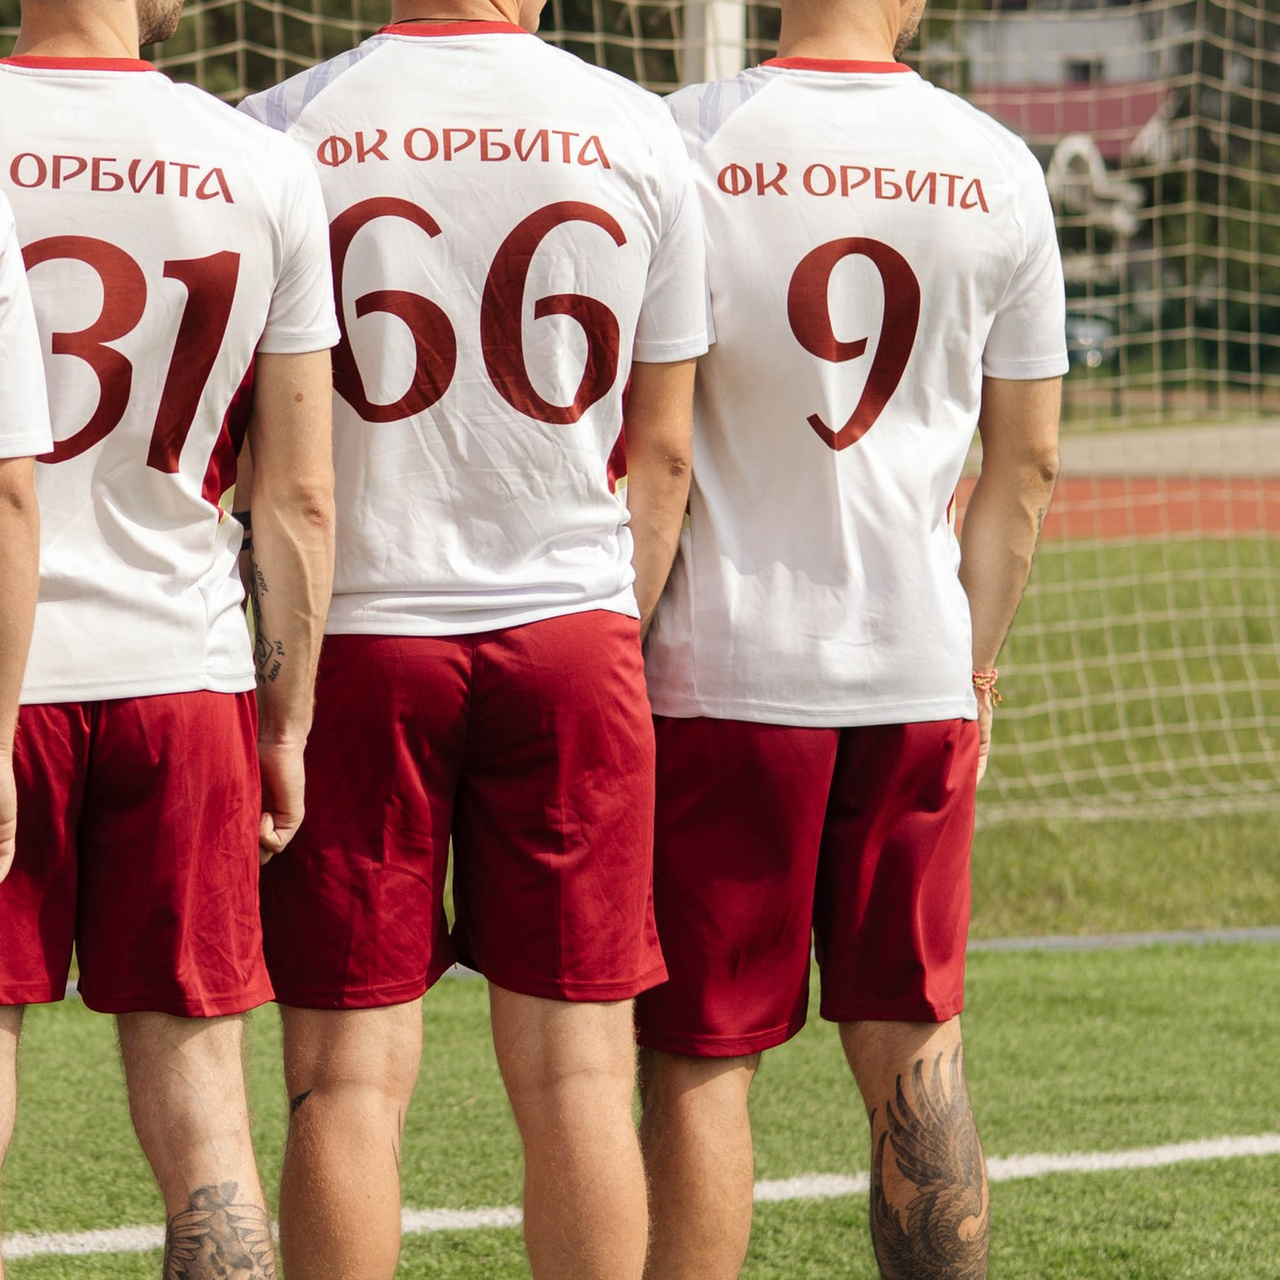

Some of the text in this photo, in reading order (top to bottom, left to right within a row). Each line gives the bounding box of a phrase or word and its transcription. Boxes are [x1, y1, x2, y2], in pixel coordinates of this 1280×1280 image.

[10, 153, 234, 204] ОРБИТА
[317, 128, 611, 170] ФК ОРБИТА
[717, 163, 989, 213] ФК ОРБИТА
[21, 235, 240, 474] 31
[328, 197, 628, 425] 66
[787, 237, 921, 451] 9
